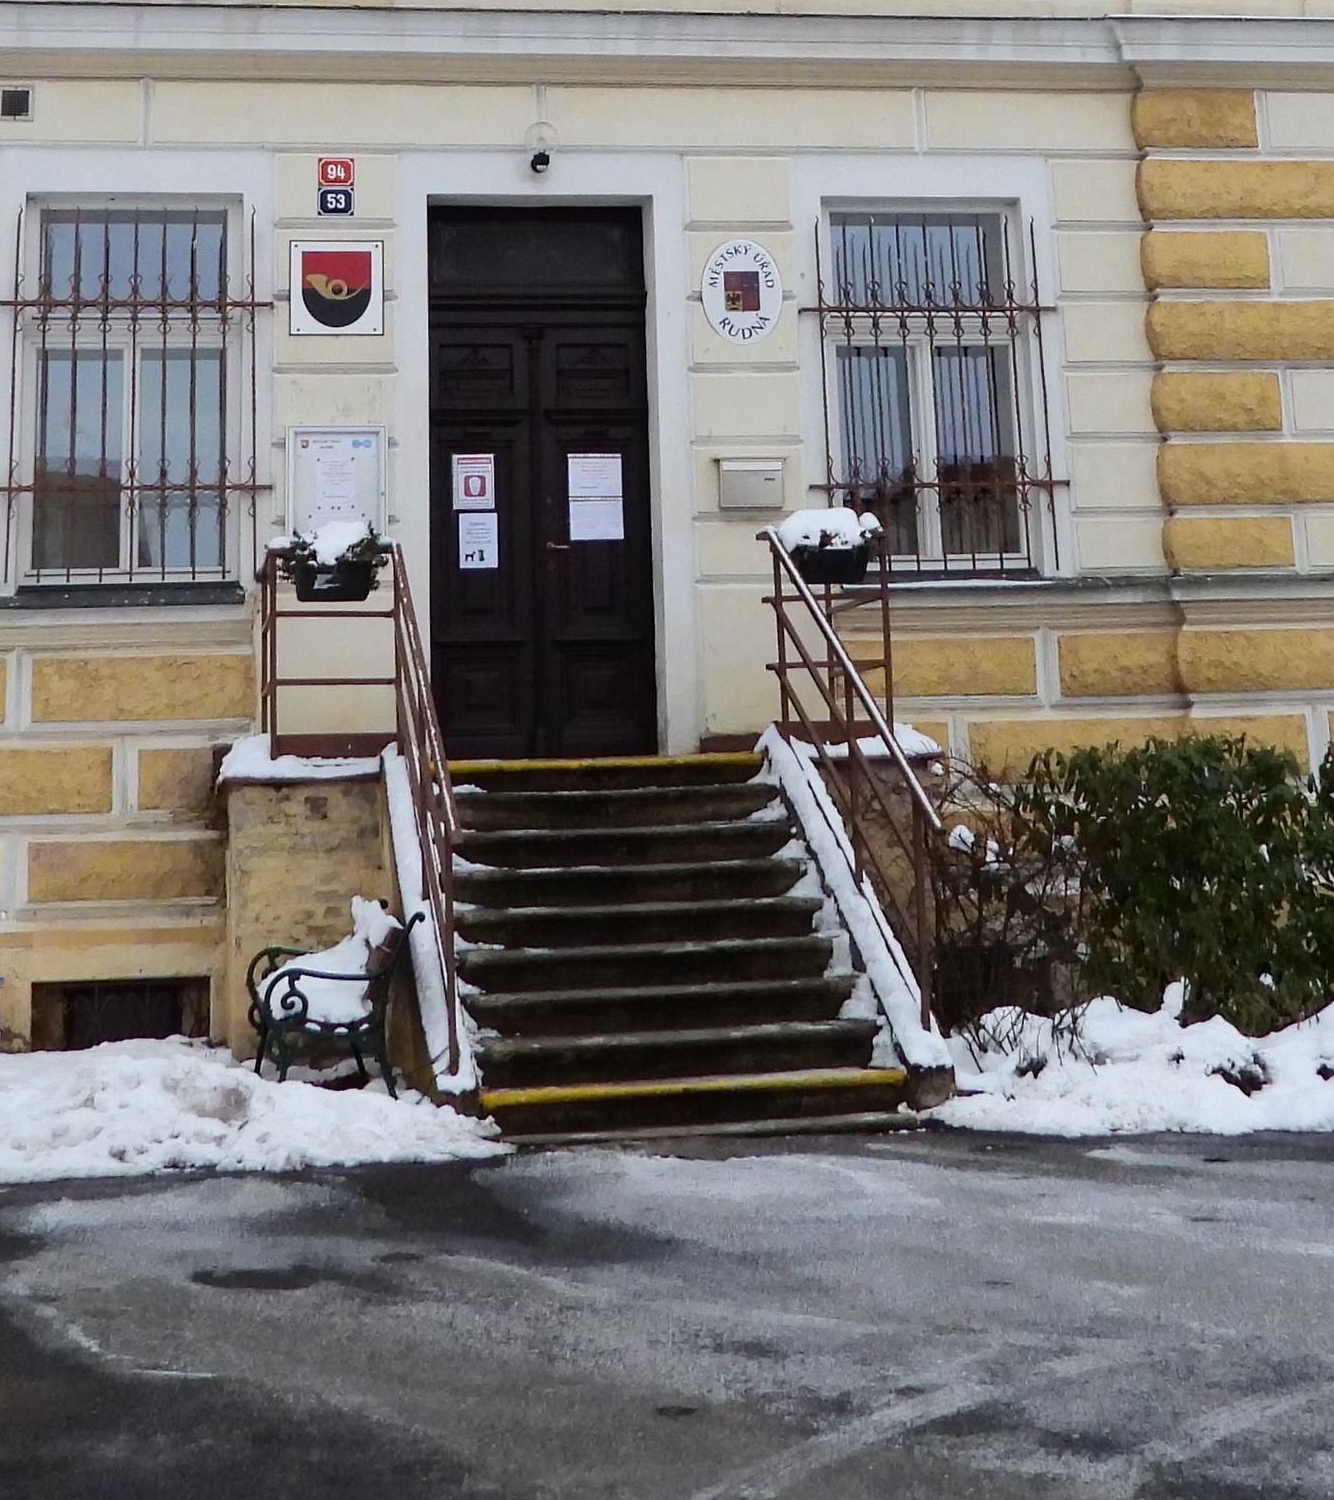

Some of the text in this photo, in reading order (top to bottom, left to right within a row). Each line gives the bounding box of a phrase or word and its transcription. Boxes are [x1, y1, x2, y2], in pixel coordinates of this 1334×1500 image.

[327, 164, 345, 180] 94
[327, 194, 345, 209] 53
[708, 244, 775, 289] MĚSTSKÝ ÚŘAD
[719, 313, 771, 340] RUDNÁ
